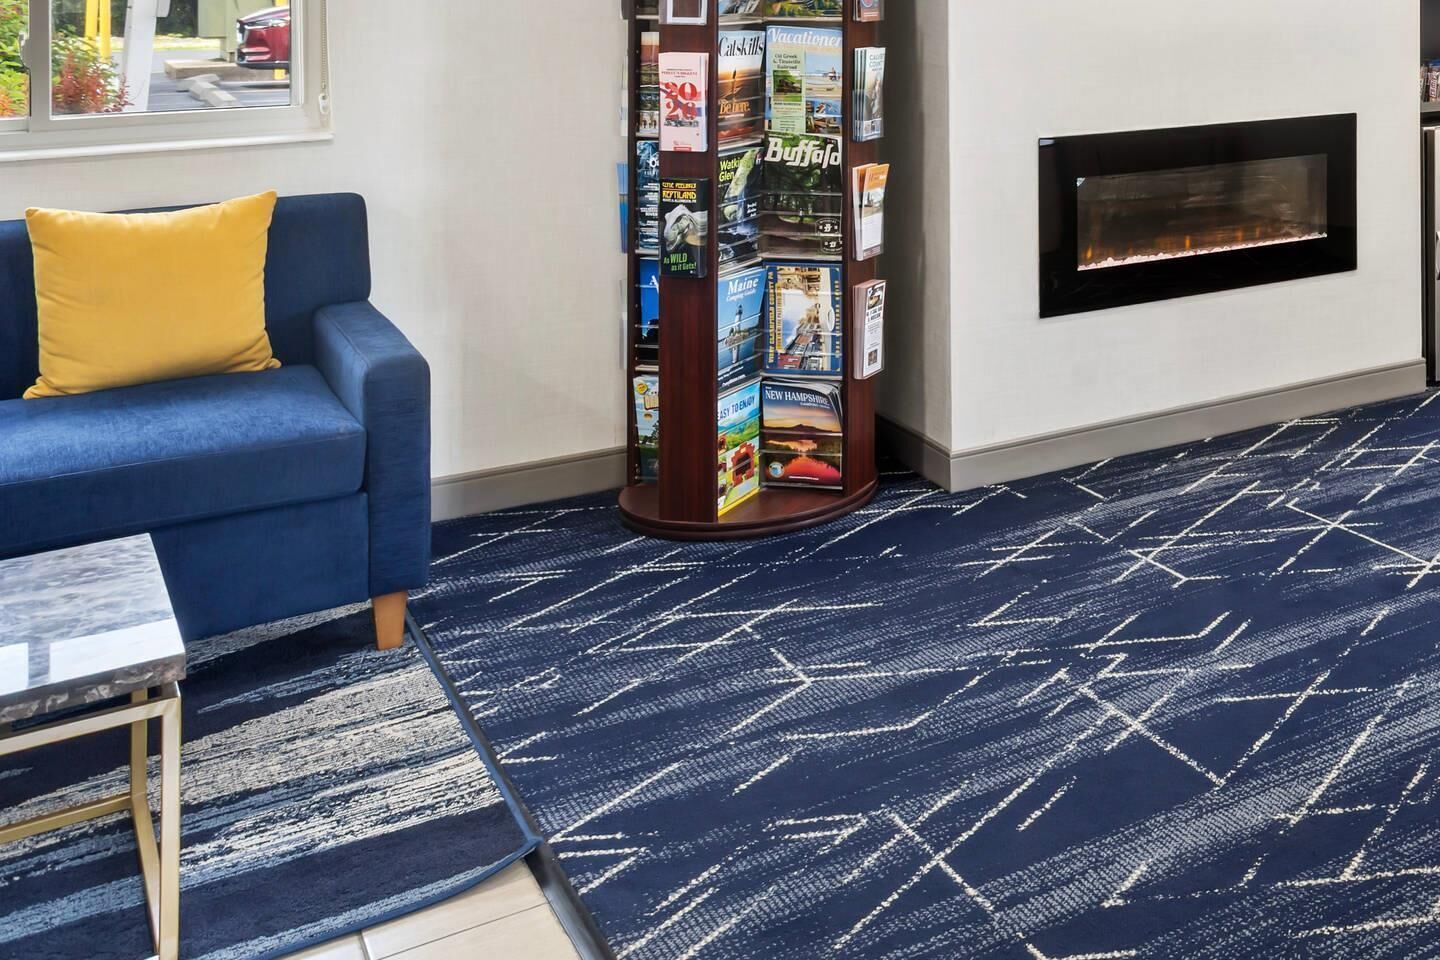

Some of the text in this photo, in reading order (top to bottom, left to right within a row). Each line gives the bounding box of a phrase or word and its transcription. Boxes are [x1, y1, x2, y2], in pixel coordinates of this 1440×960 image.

[719, 34, 764, 57] Catskills
[767, 27, 842, 47] Vacationer
[764, 136, 841, 169] Buffalo
[719, 171, 735, 182] Glen
[662, 190, 697, 199] REPTILAND
[670, 252, 688, 264] WILD
[727, 277, 759, 295] Maine
[765, 389, 784, 401] NEW
[784, 391, 829, 405] HAMPSHIRE
[718, 395, 756, 419] ASY TO ENJOY
